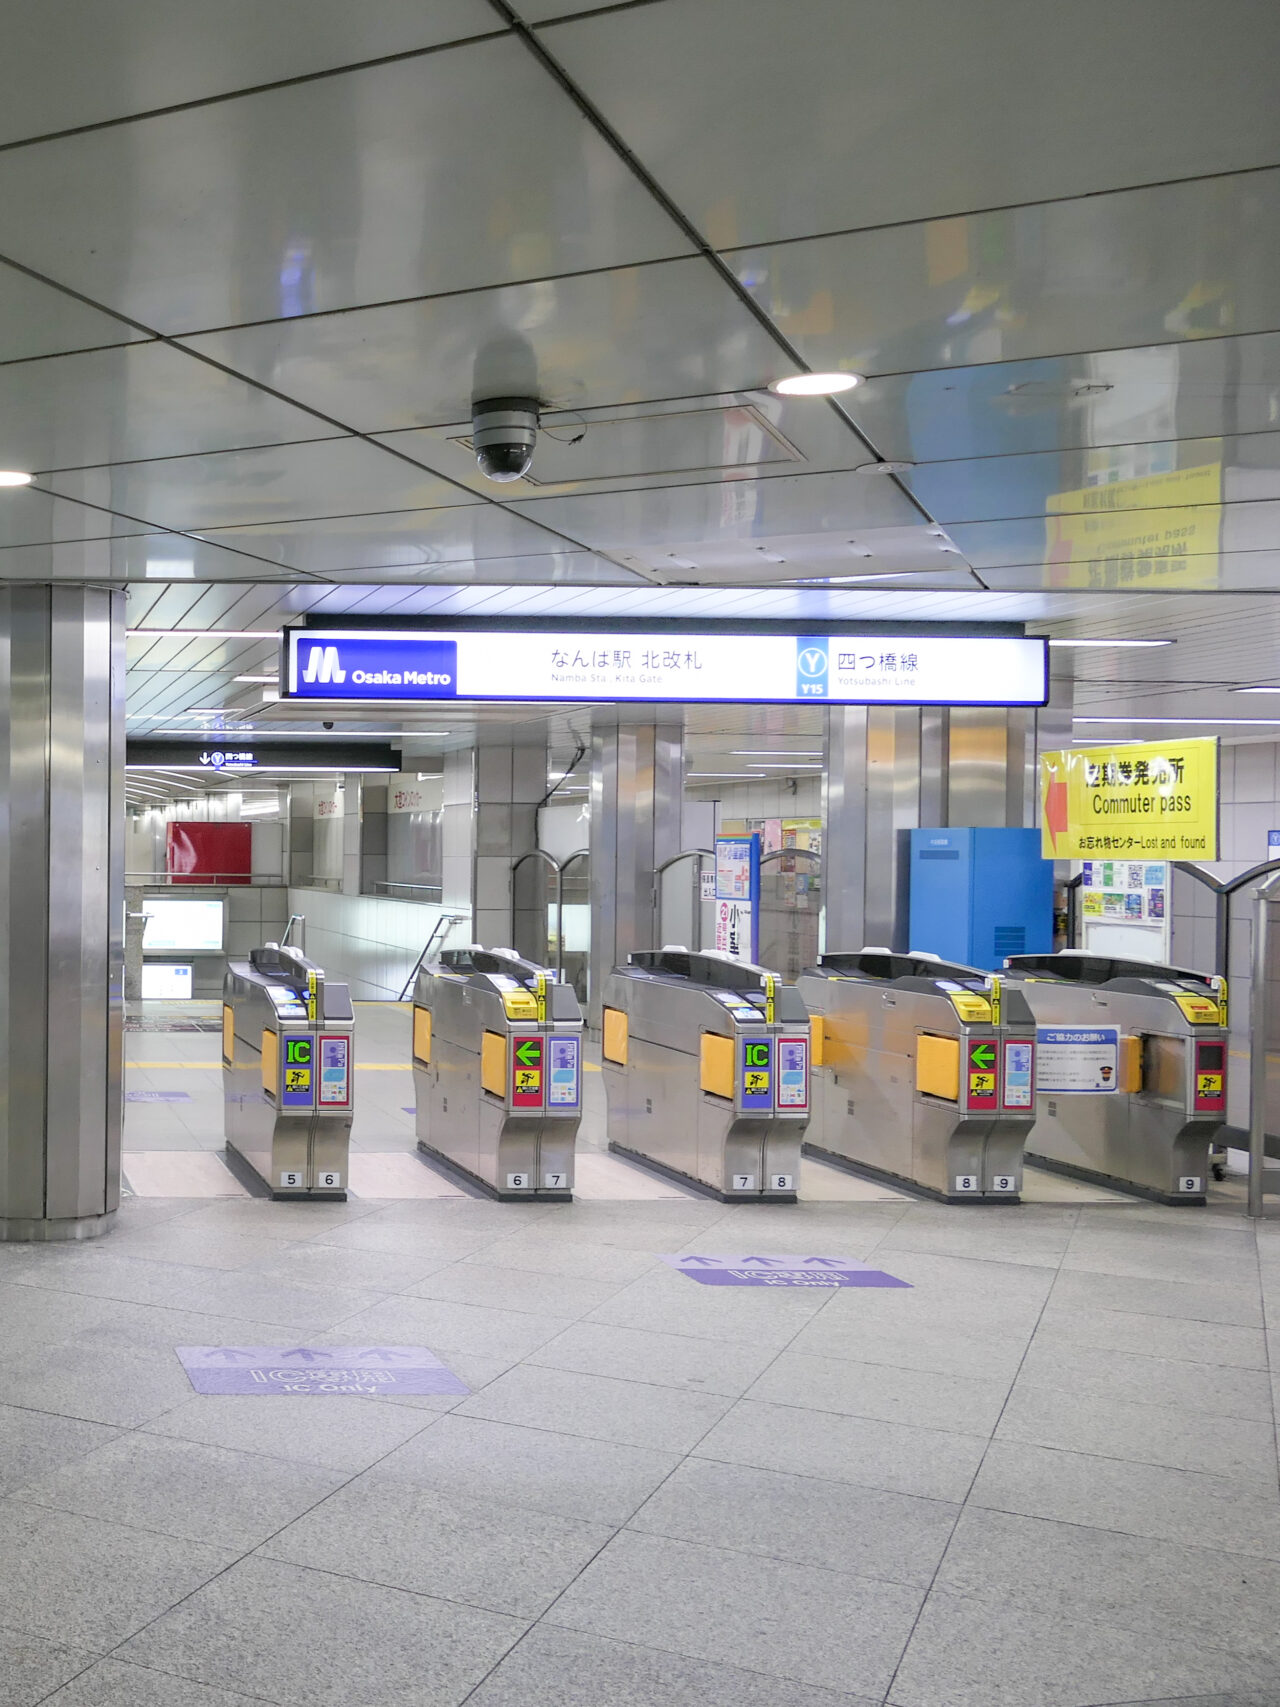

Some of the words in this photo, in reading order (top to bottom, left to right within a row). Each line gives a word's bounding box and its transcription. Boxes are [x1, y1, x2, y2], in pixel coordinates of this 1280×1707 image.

[552, 649, 631, 668] なんば駅
[641, 650, 702, 669] 北改札
[805, 653, 819, 673] Y
[838, 653, 918, 672] 四つ橋線
[352, 670, 401, 684] Osaka
[403, 671, 451, 685] Metro
[551, 673, 587, 682] Namba
[615, 674, 636, 683] Kita
[639, 674, 663, 683] Gate
[838, 677, 891, 686] Yotsubashi
[895, 677, 915, 686] Line
[801, 684, 823, 694] Y15
[1093, 793, 1155, 814] Commuter
[1160, 794, 1191, 815] pass
[1141, 836, 1158, 849] Lost
[1160, 836, 1176, 849] and
[1180, 835, 1206, 849] found
[287, 1041, 310, 1062] IC
[745, 1045, 768, 1066] IC
[287, 1174, 296, 1185] 5
[325, 1174, 334, 1185] 6
[513, 1175, 522, 1186] 6
[551, 1175, 560, 1186] 7
[739, 1176, 748, 1187] 7
[777, 1176, 786, 1188] 8
[962, 1177, 971, 1189] 8
[999, 1178, 1009, 1189] 9
[1186, 1179, 1194, 1190] 9
[792, 1279, 839, 1287] Only
[282, 1384, 312, 1392] IC
[319, 1383, 377, 1393] Only
